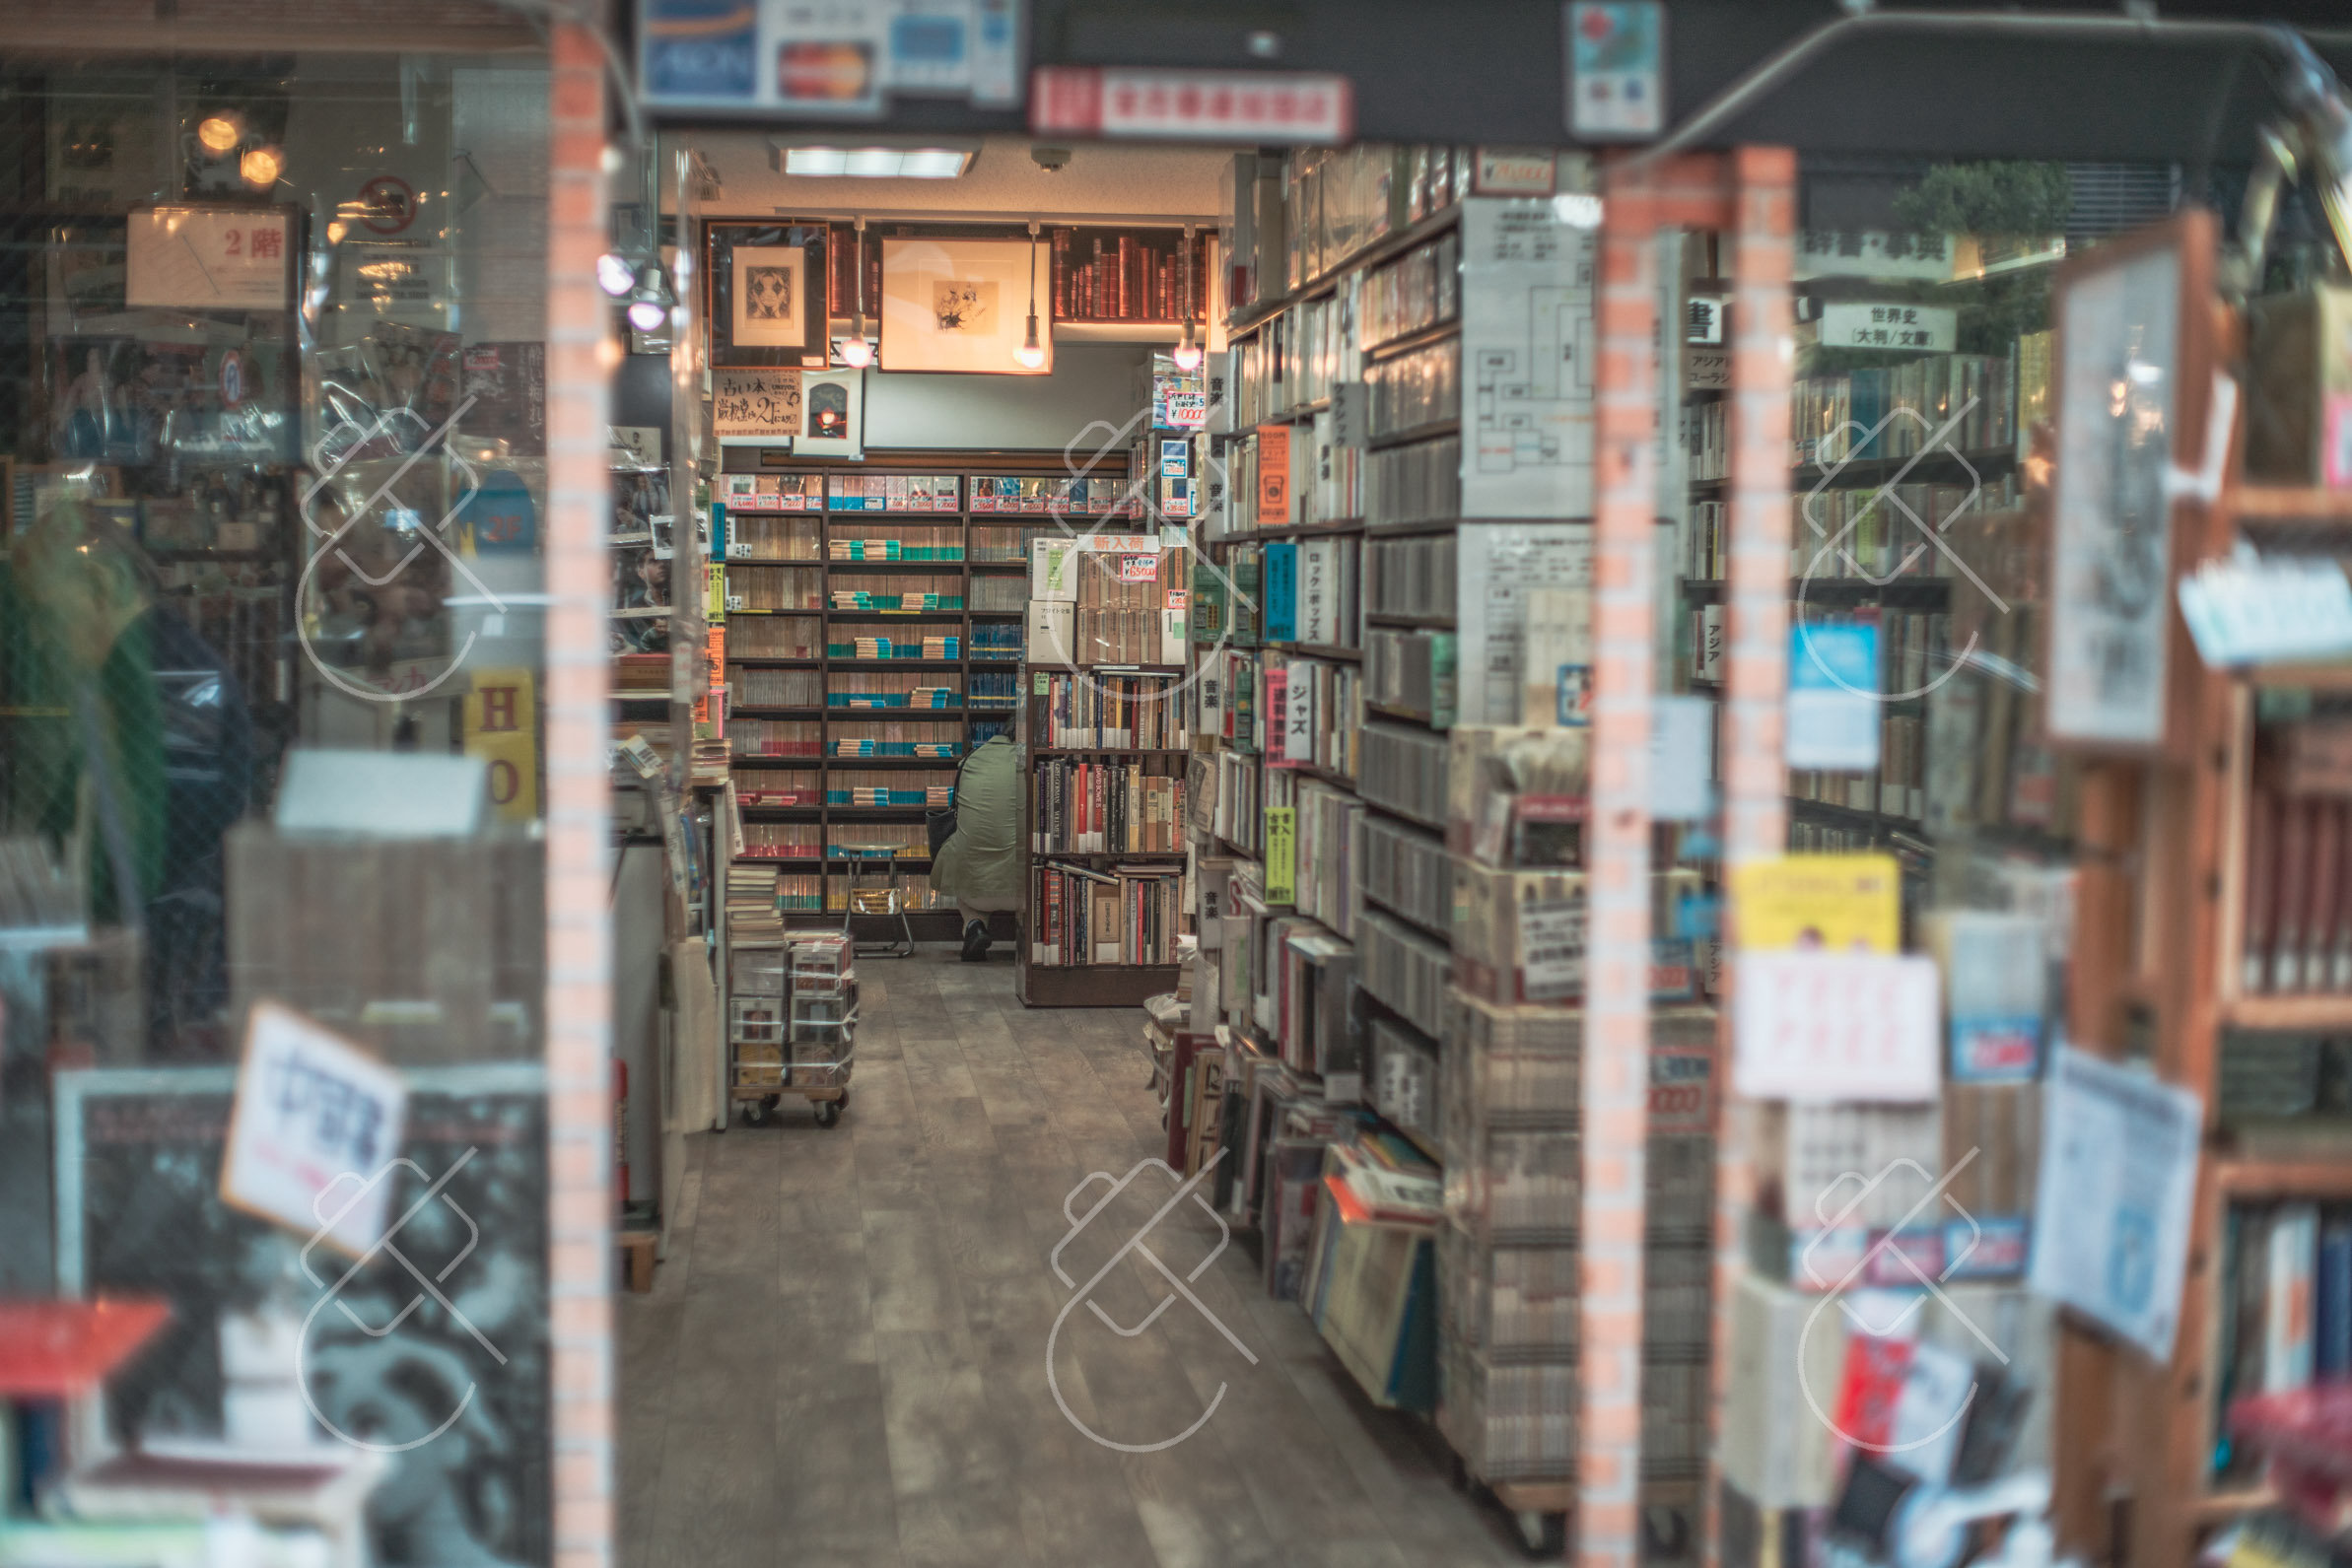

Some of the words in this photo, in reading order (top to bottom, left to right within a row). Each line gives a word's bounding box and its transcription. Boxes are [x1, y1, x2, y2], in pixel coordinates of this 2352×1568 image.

[226, 228, 283, 259] 2階
[1871, 307, 1918, 325] 世界史
[723, 377, 766, 397] 古い本
[1210, 376, 1224, 406] 音楽
[1334, 383, 1347, 448] クラシック
[1209, 483, 1224, 512] 音楽
[487, 515, 522, 541] 2F
[1093, 535, 1144, 551] 新入荷
[1708, 624, 1721, 662] アジア
[1204, 679, 1218, 709] 音楽
[1290, 685, 1308, 735] ジャズ
[1204, 891, 1219, 920] 音楽
